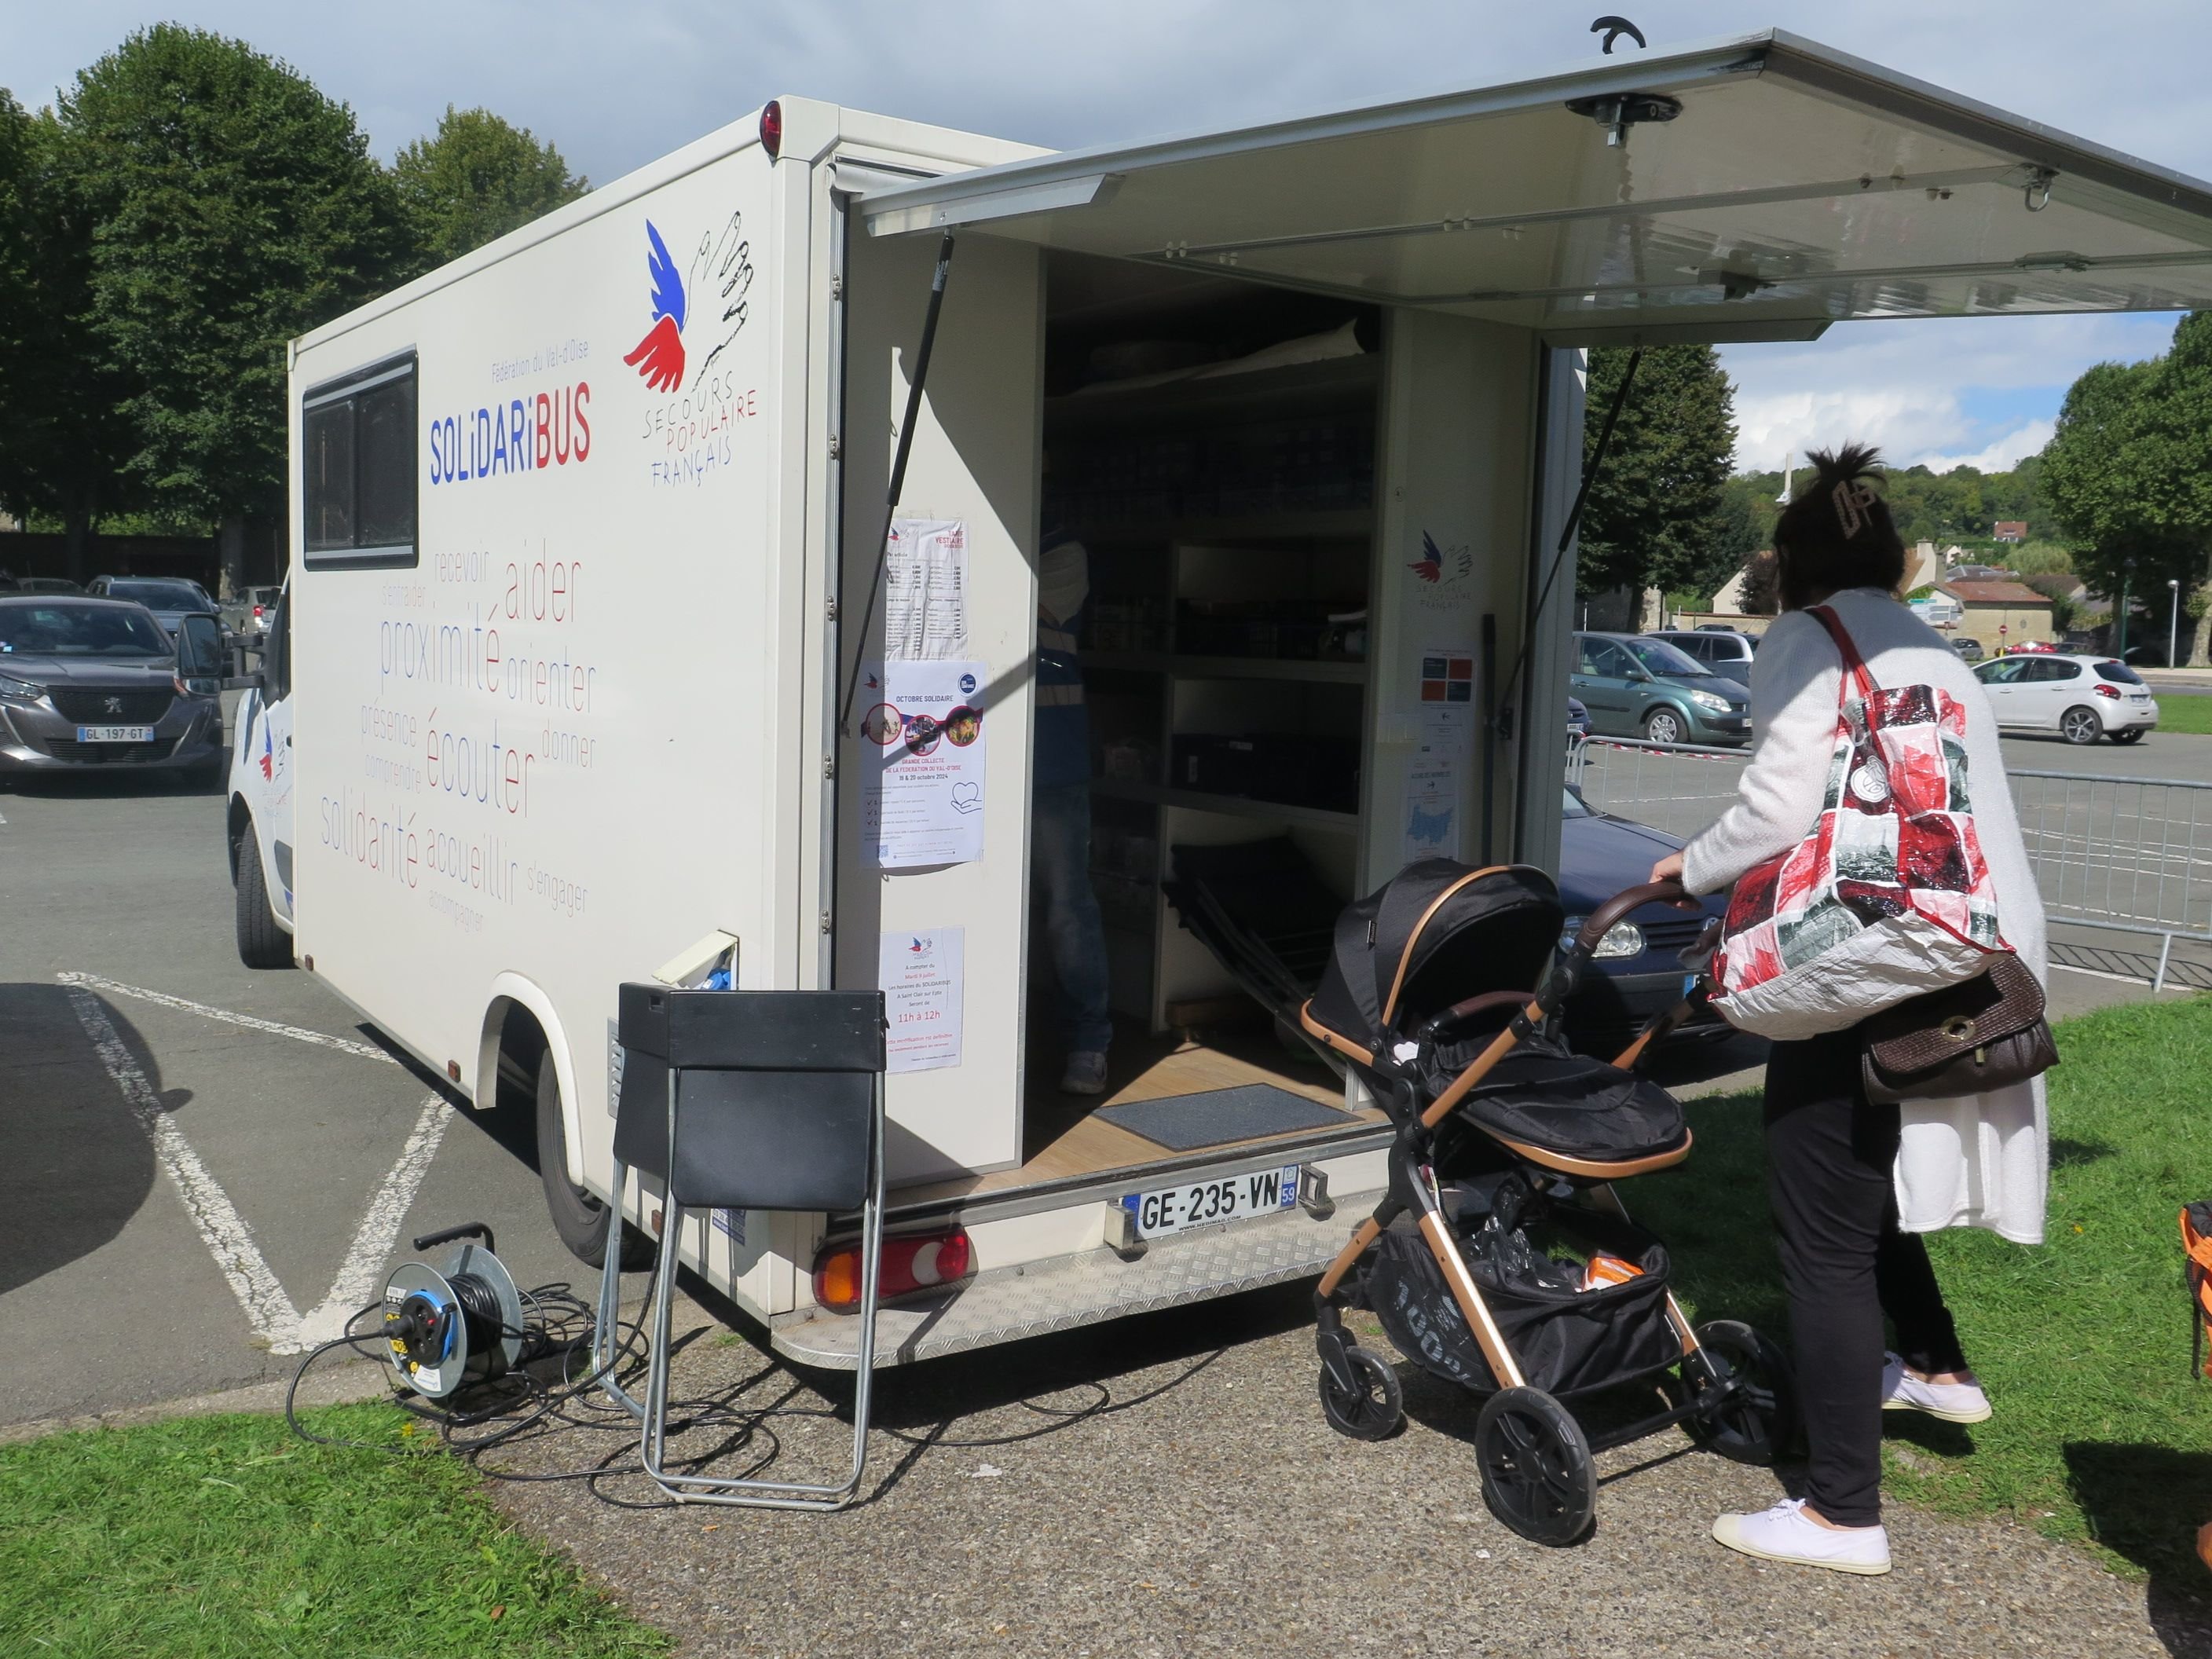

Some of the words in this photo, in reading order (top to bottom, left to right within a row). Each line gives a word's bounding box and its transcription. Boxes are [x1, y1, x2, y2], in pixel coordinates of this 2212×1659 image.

[491, 357, 530, 384] Fédération
[533, 351, 544, 372] du
[546, 339, 589, 368] Val-d'Oise
[643, 371, 733, 439] SECOURS
[666, 390, 757, 453] POPULAIRE
[651, 435, 731, 487] FRANÇAIS
[434, 539, 489, 582] recevoir
[505, 537, 582, 624] aider
[380, 602, 500, 695] proximité
[507, 643, 596, 713] orienter
[86, 728, 143, 739] GL-197-GT
[361, 697, 417, 749] présence
[542, 718, 596, 769] donner
[364, 753, 421, 794] comprendre
[427, 706, 535, 818] écouter
[321, 785, 419, 888] solidarité
[427, 828, 518, 905] accueillir
[527, 860, 588, 917] s'engager
[429, 888, 484, 934] accompagner
[899, 1013, 914, 1023] 11h
[917, 1012, 921, 1020] à
[925, 1010, 940, 1020] 12h
[1142, 1171, 1280, 1230] GE-235-VN
[1281, 1187, 1295, 1203] 59
